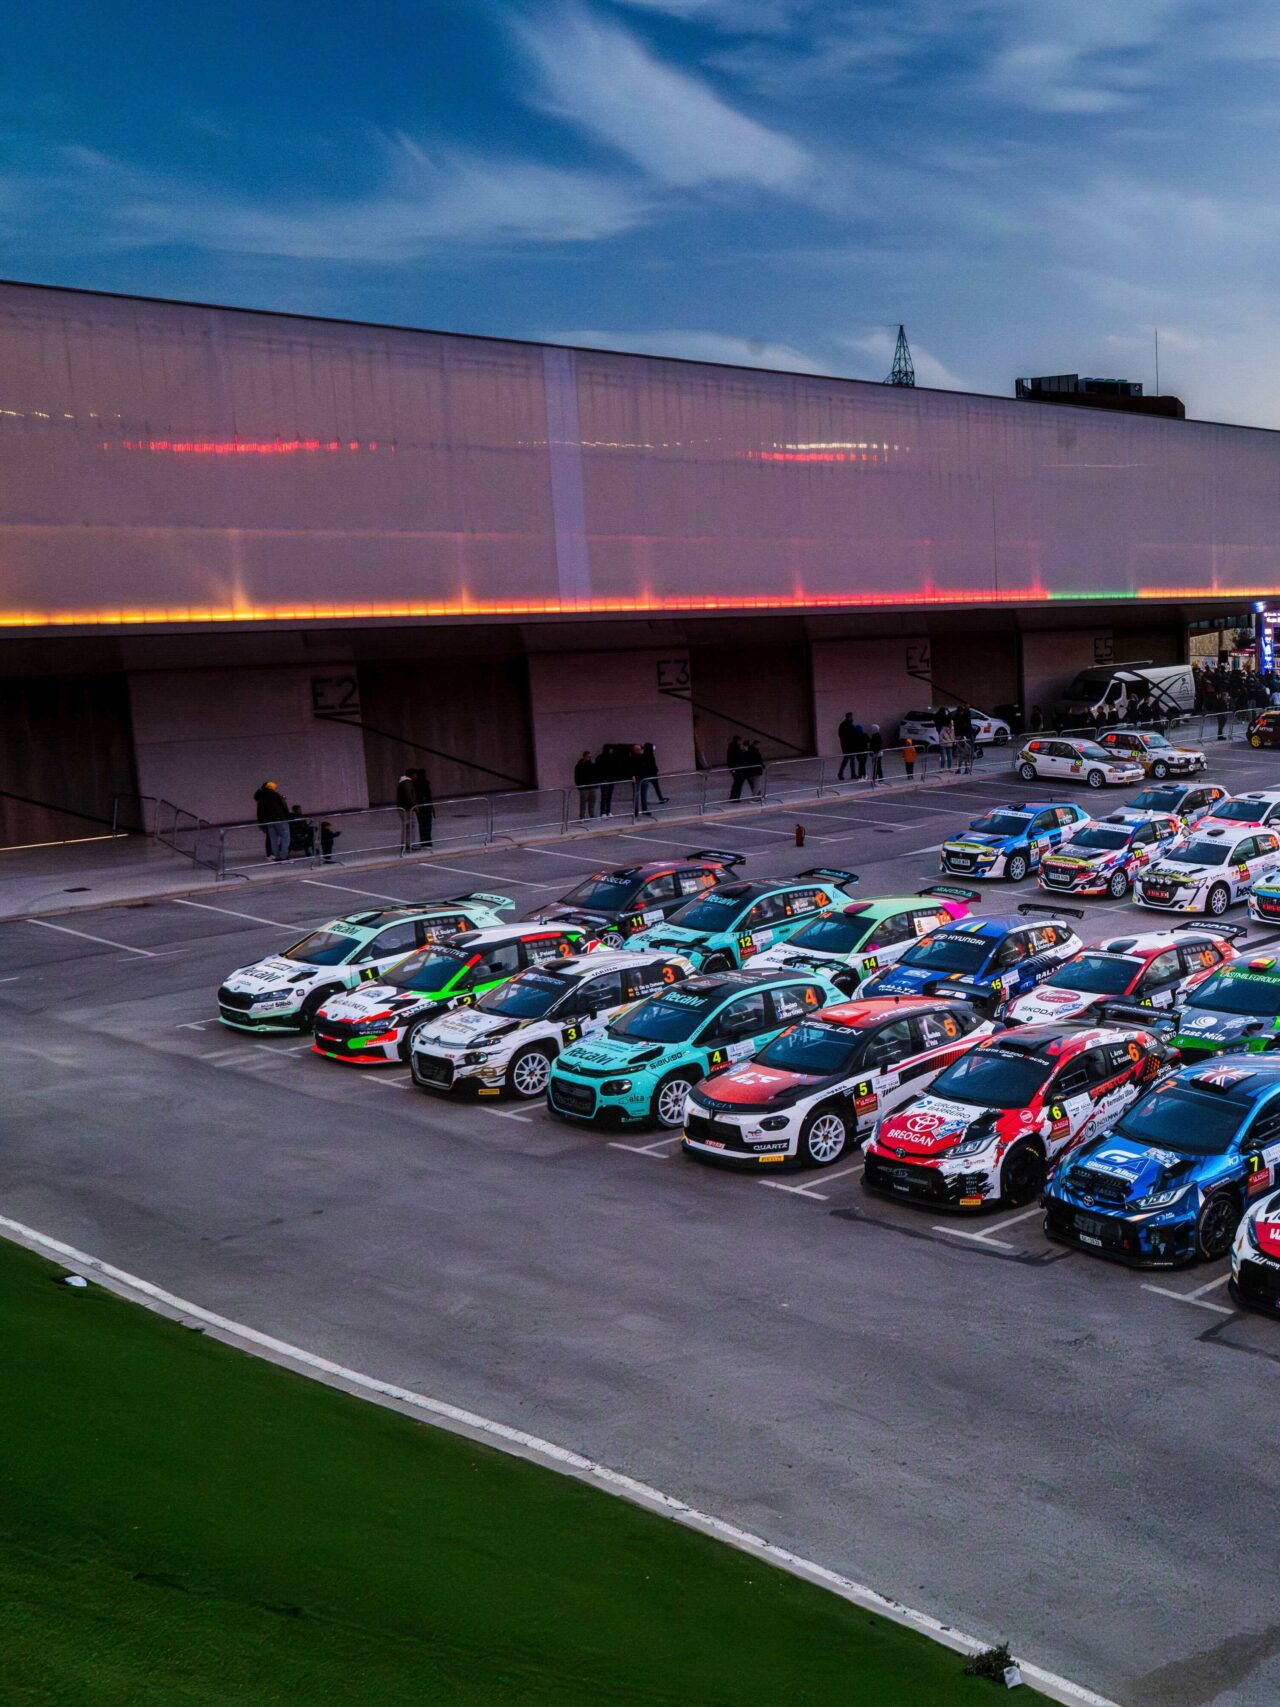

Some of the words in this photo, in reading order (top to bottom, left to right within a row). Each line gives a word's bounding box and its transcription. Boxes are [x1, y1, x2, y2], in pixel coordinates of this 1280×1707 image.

[1094, 637, 1113, 658] E5
[906, 646, 930, 670] E4
[657, 659, 690, 687] E3
[311, 677, 359, 710] E2
[632, 915, 643, 928] 11
[739, 936, 752, 948] 12
[948, 934, 988, 947] HYUNDAI
[1041, 928, 1057, 944] 15
[559, 943, 573, 958] 2
[864, 956, 877, 970] 14
[662, 967, 676, 985] 3
[991, 978, 1002, 990] 15
[805, 987, 816, 1005] 4
[877, 984, 918, 994] RALLYE
[663, 991, 708, 1008] Recalvi
[568, 1027, 577, 1040] 3
[801, 1019, 864, 1036] YPSILON
[944, 1018, 956, 1036] 5
[1178, 1026, 1203, 1038] Last
[1203, 1031, 1228, 1042] Mile
[1160, 1031, 1178, 1043] KINTO
[565, 1046, 618, 1066] Recalvi
[713, 1051, 722, 1063] 4
[1127, 1042, 1140, 1063] 6
[859, 1081, 869, 1096] 5
[927, 1105, 972, 1120] BARREIRO
[933, 1101, 965, 1112] GRUPO
[1052, 1104, 1063, 1120] 6
[887, 1128, 935, 1147] BREOGAN
[753, 1142, 789, 1152] QUARTZ
[1085, 1159, 1112, 1175] Glenn
[1113, 1166, 1140, 1181] Allen
[1250, 1156, 1259, 1172] 7
